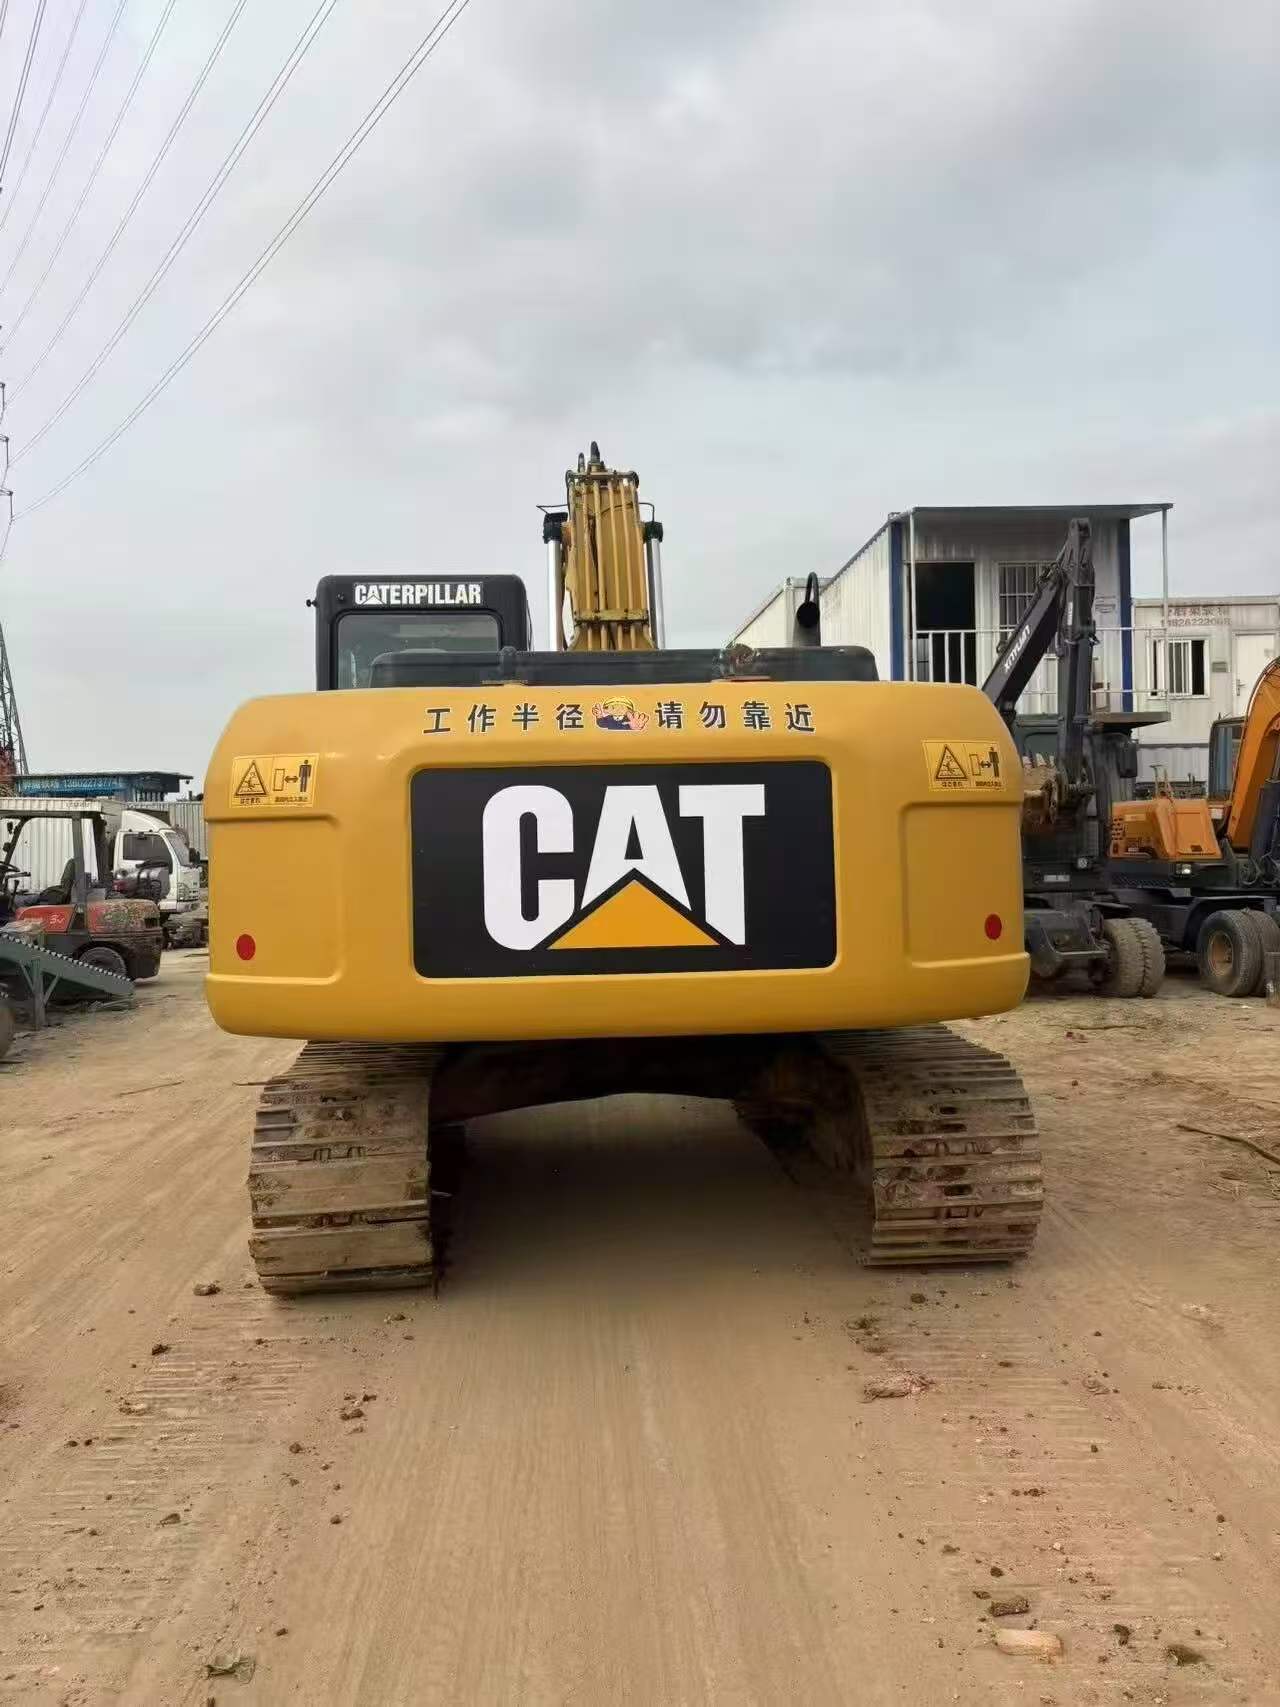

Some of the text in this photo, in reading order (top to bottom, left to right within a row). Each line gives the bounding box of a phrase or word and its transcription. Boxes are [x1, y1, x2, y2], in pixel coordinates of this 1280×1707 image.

[354, 583, 481, 605] CATERPILLAR
[423, 700, 816, 733] 工作半径 请勿靠近
[482, 783, 766, 951] CAT
